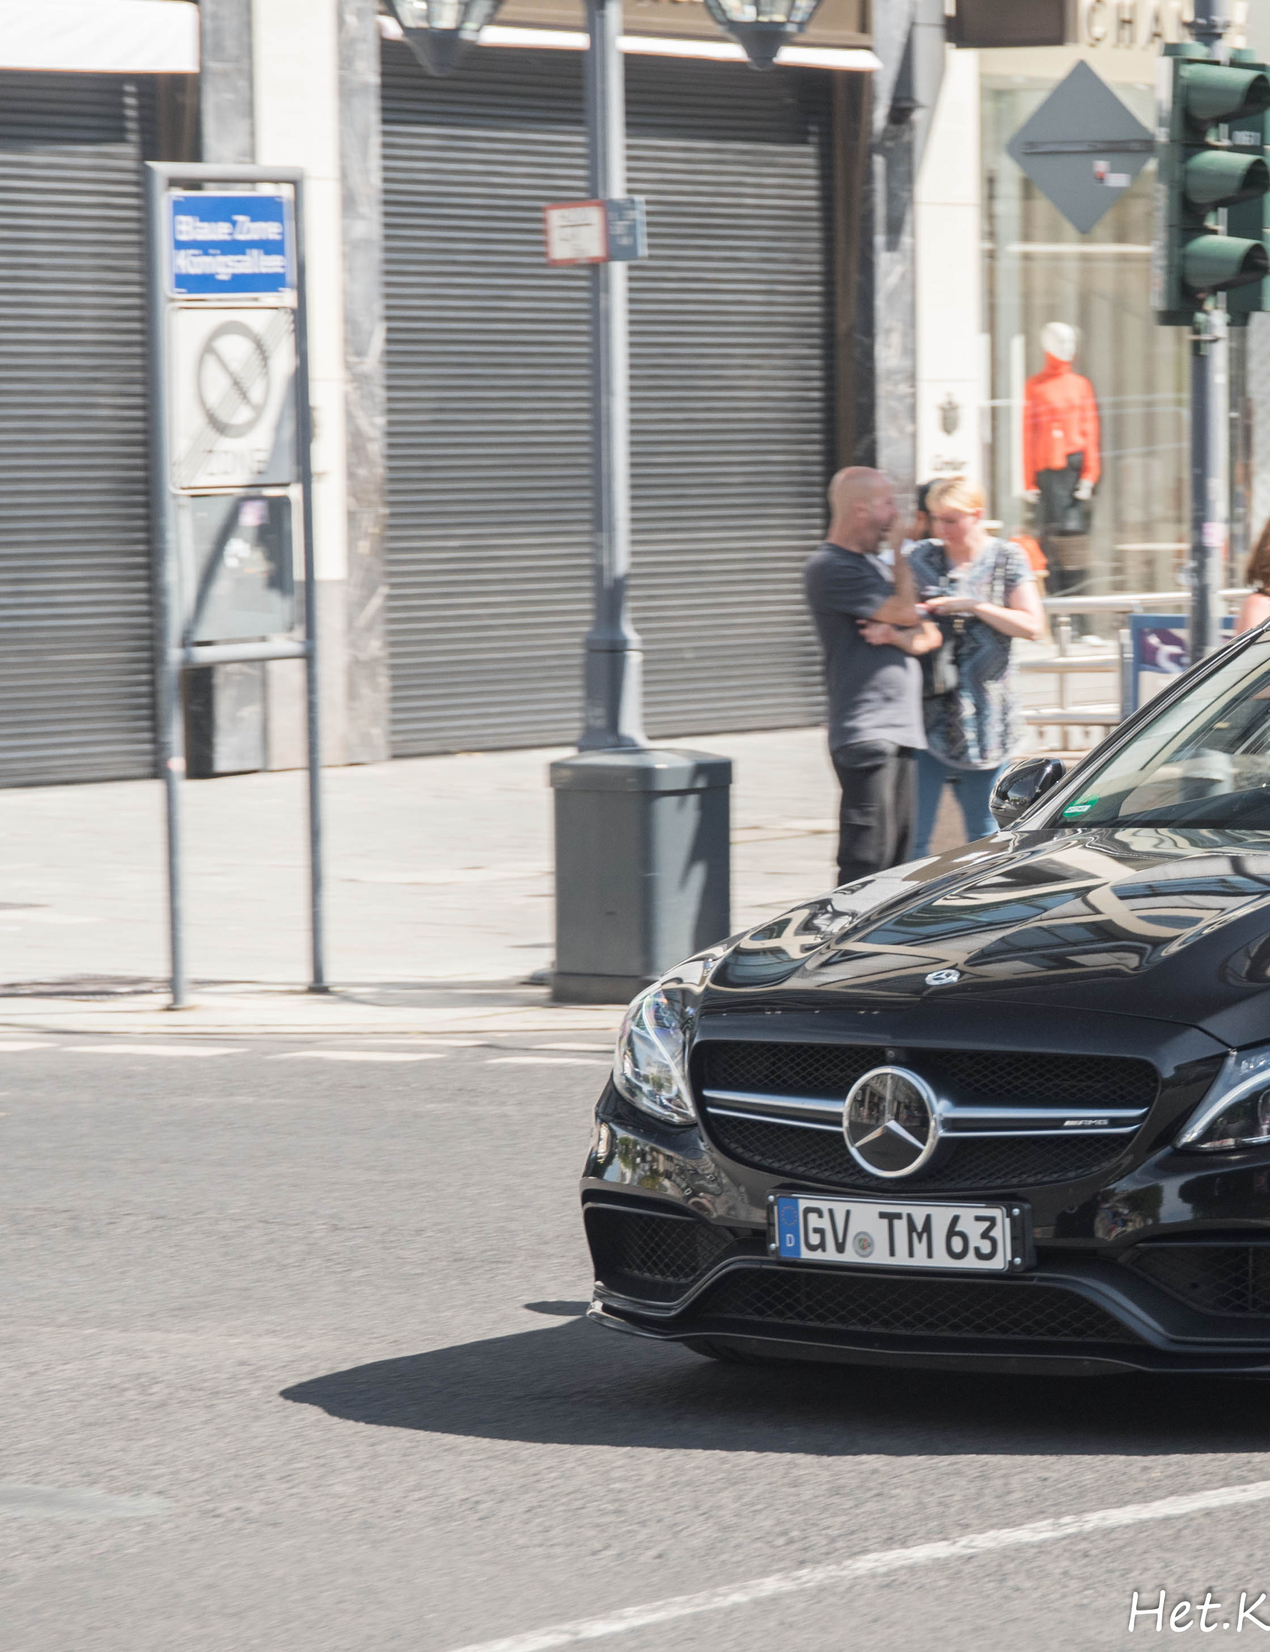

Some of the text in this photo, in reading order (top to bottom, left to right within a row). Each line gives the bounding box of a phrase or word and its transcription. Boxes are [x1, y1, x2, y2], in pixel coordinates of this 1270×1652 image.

[174, 214, 283, 241] Blaue Zone
[786, 1233, 794, 1247] D
[802, 1206, 998, 1261] GV TM 63
